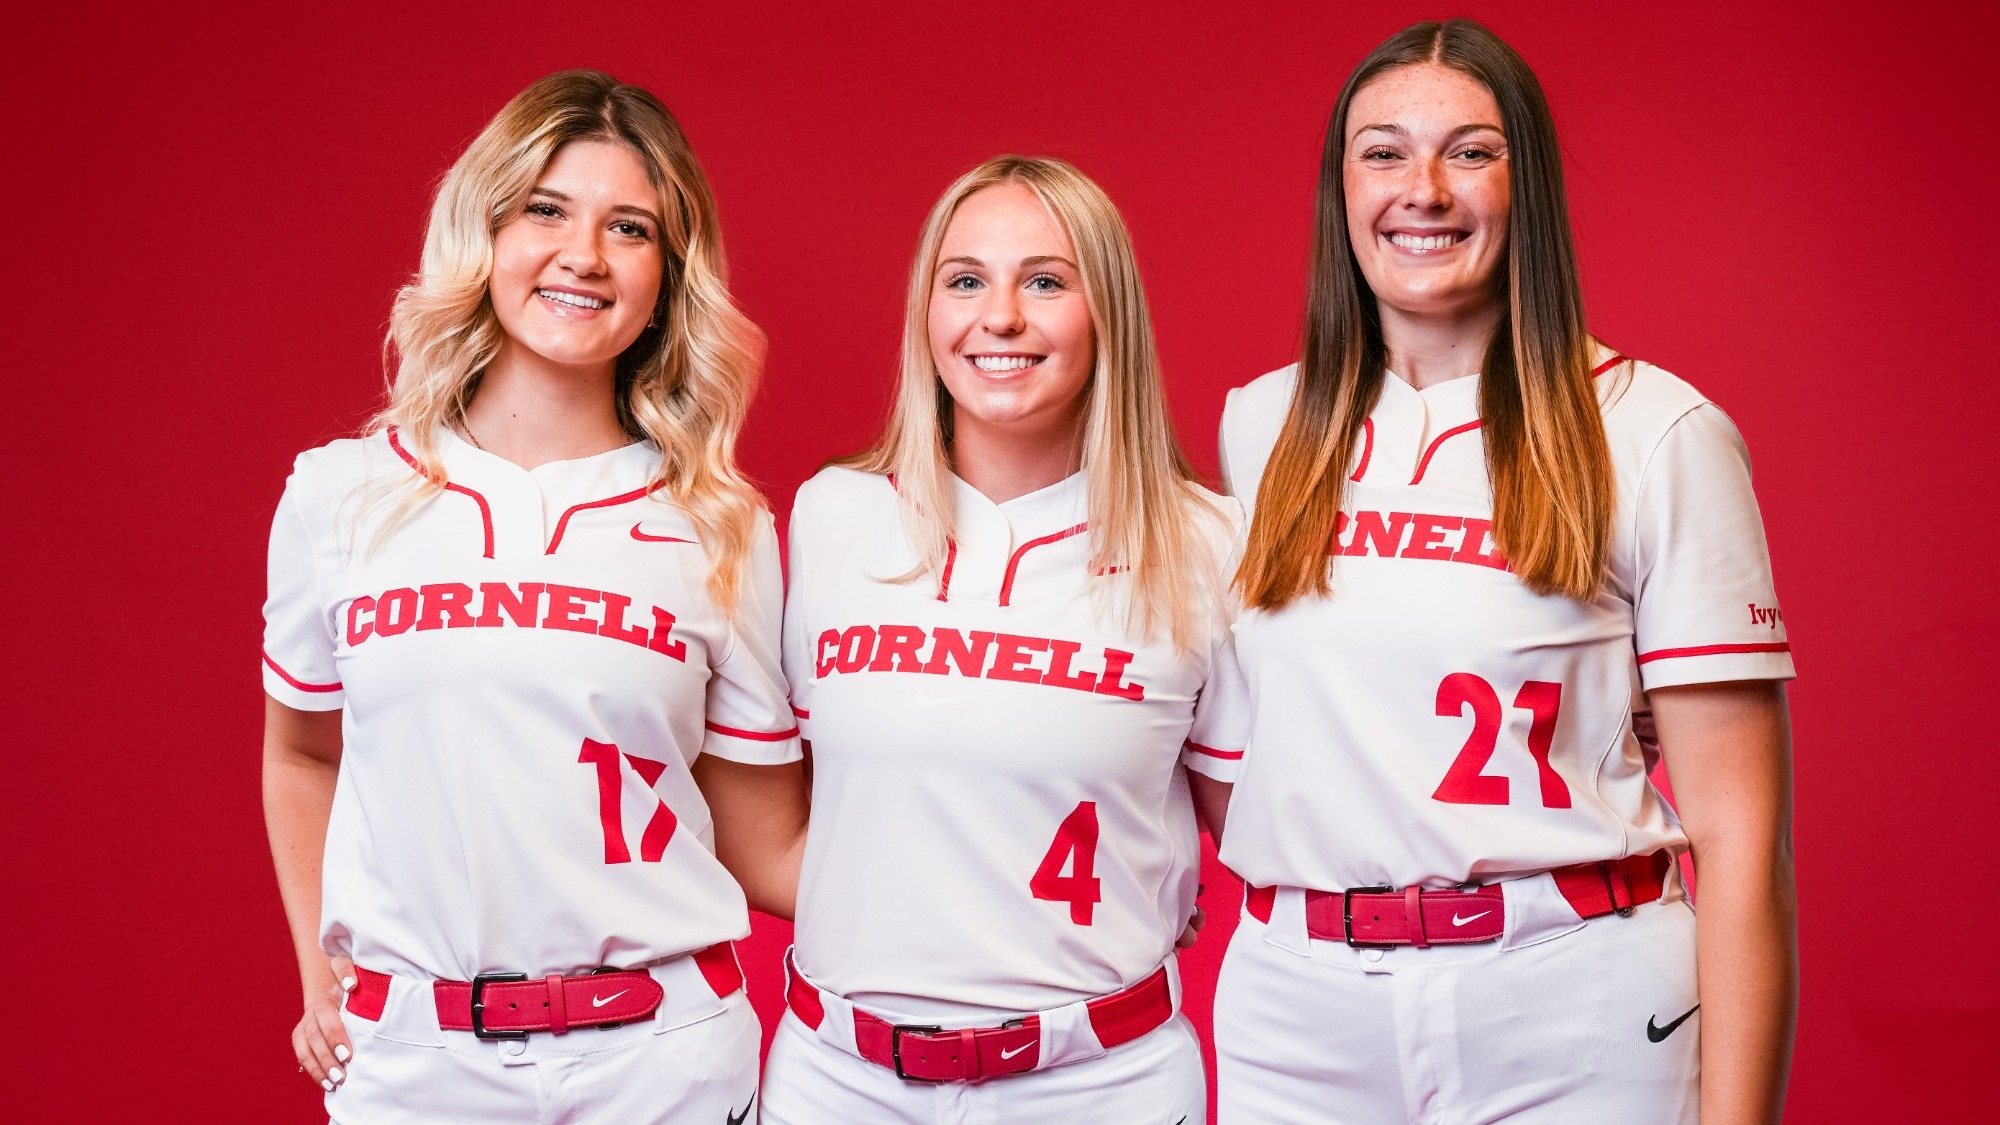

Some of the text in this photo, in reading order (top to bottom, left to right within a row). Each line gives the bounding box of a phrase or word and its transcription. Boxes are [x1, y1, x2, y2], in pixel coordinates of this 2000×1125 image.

[1326, 511, 1517, 575] NEL
[347, 582, 687, 662] CORNELL
[1748, 603, 1782, 629] Ivy
[815, 625, 1144, 702] CORNELL
[1431, 672, 1572, 809] 21
[578, 738, 677, 864] 17
[1029, 801, 1101, 926] 4
